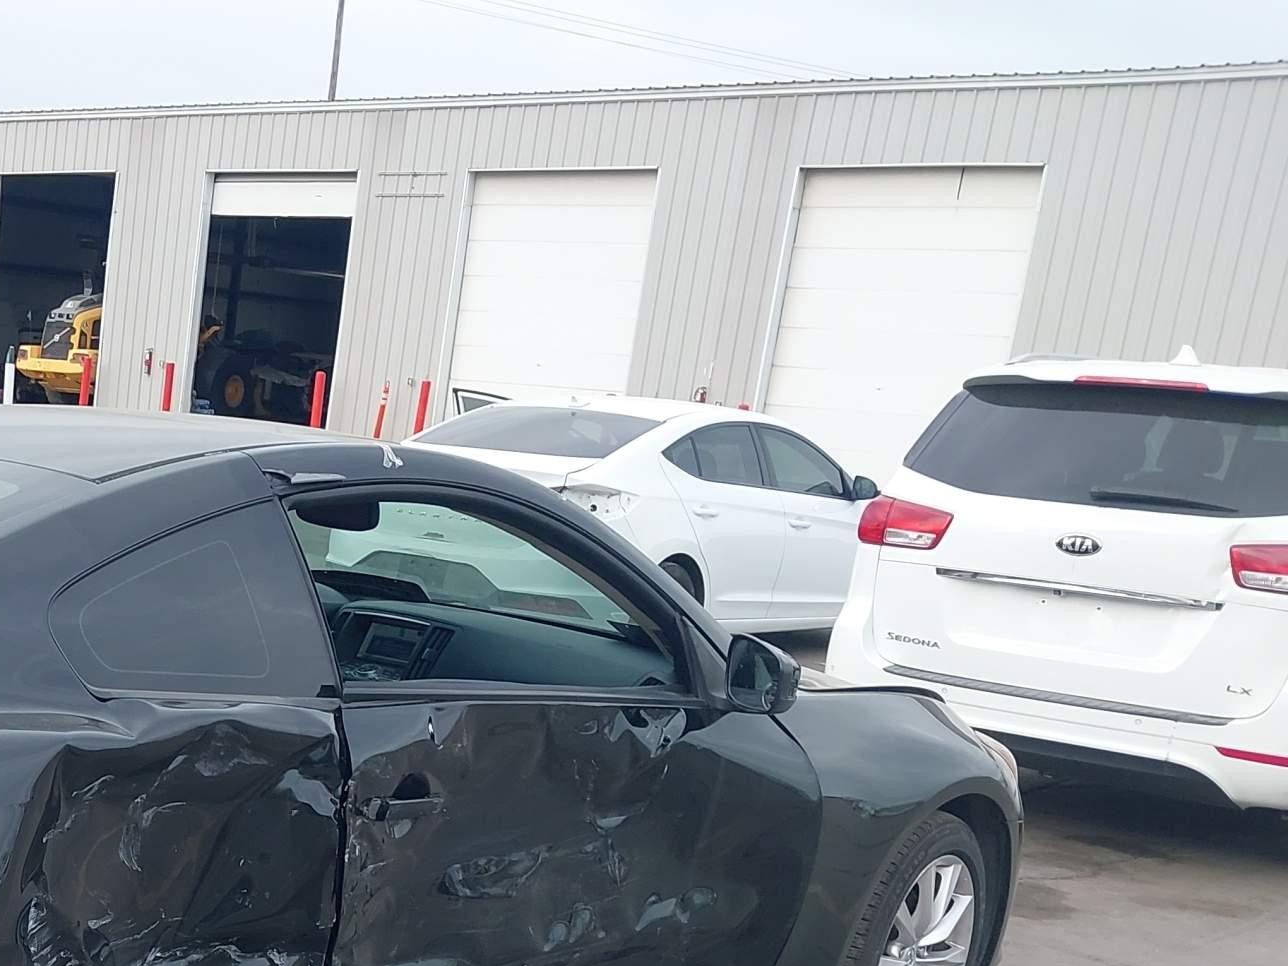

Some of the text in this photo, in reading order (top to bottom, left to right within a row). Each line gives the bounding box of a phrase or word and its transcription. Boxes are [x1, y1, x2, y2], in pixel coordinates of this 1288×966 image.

[1062, 537, 1093, 552] KIA
[886, 631, 941, 650] SEDONA
[1226, 684, 1253, 696] LX
